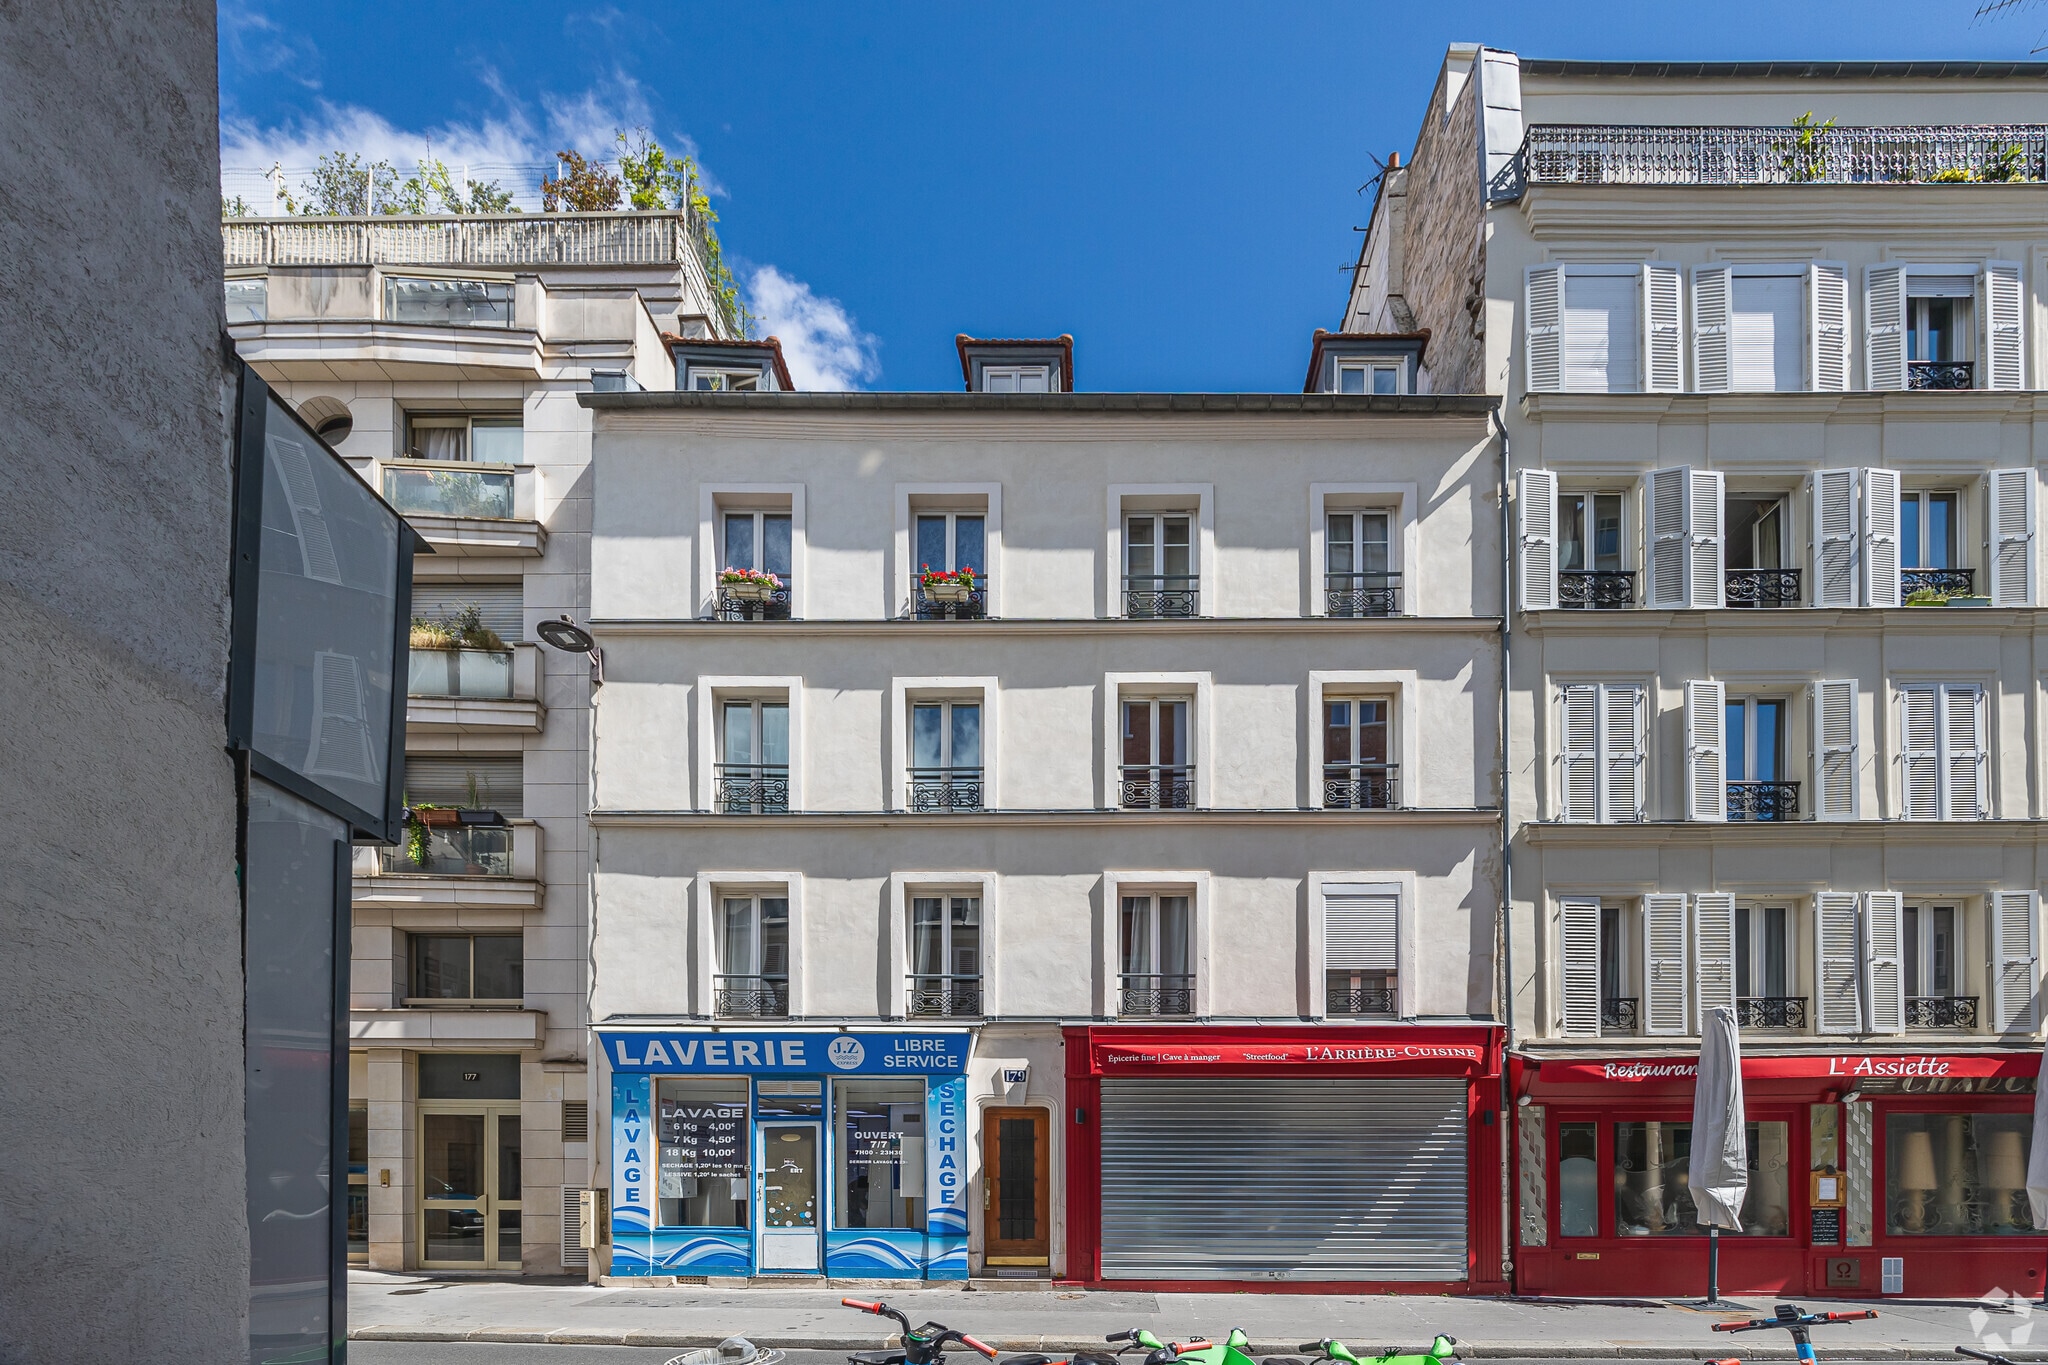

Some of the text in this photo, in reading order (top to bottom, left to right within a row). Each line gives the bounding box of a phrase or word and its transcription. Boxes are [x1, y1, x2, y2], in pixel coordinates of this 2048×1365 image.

[894, 1039, 946, 1052] LIBRE
[615, 1040, 807, 1066] LAVERIE
[1108, 1054, 1140, 1064] Épicerie
[1141, 1053, 1156, 1062] fine
[1162, 1053, 1183, 1061] Cave
[1184, 1053, 1189, 1061] à
[1190, 1054, 1221, 1062] manger
[883, 1055, 959, 1068] SERVICE
[1853, 1057, 1950, 1076] Assiette
[1005, 1070, 1026, 1082] 179
[1604, 1062, 1699, 1079] Restauran
[464, 1073, 477, 1081] 177
[661, 1108, 744, 1118] LAVAGE
[673, 1122, 680, 1130] 6
[683, 1123, 698, 1132] Kg
[683, 1136, 698, 1145] Kg
[854, 1131, 904, 1140] OUVERT
[624, 1089, 641, 1203] LAVAGE
[870, 1140, 888, 1149] 7/7
[939, 1084, 956, 1205] SECHAGE
[682, 1149, 697, 1158] Kg
